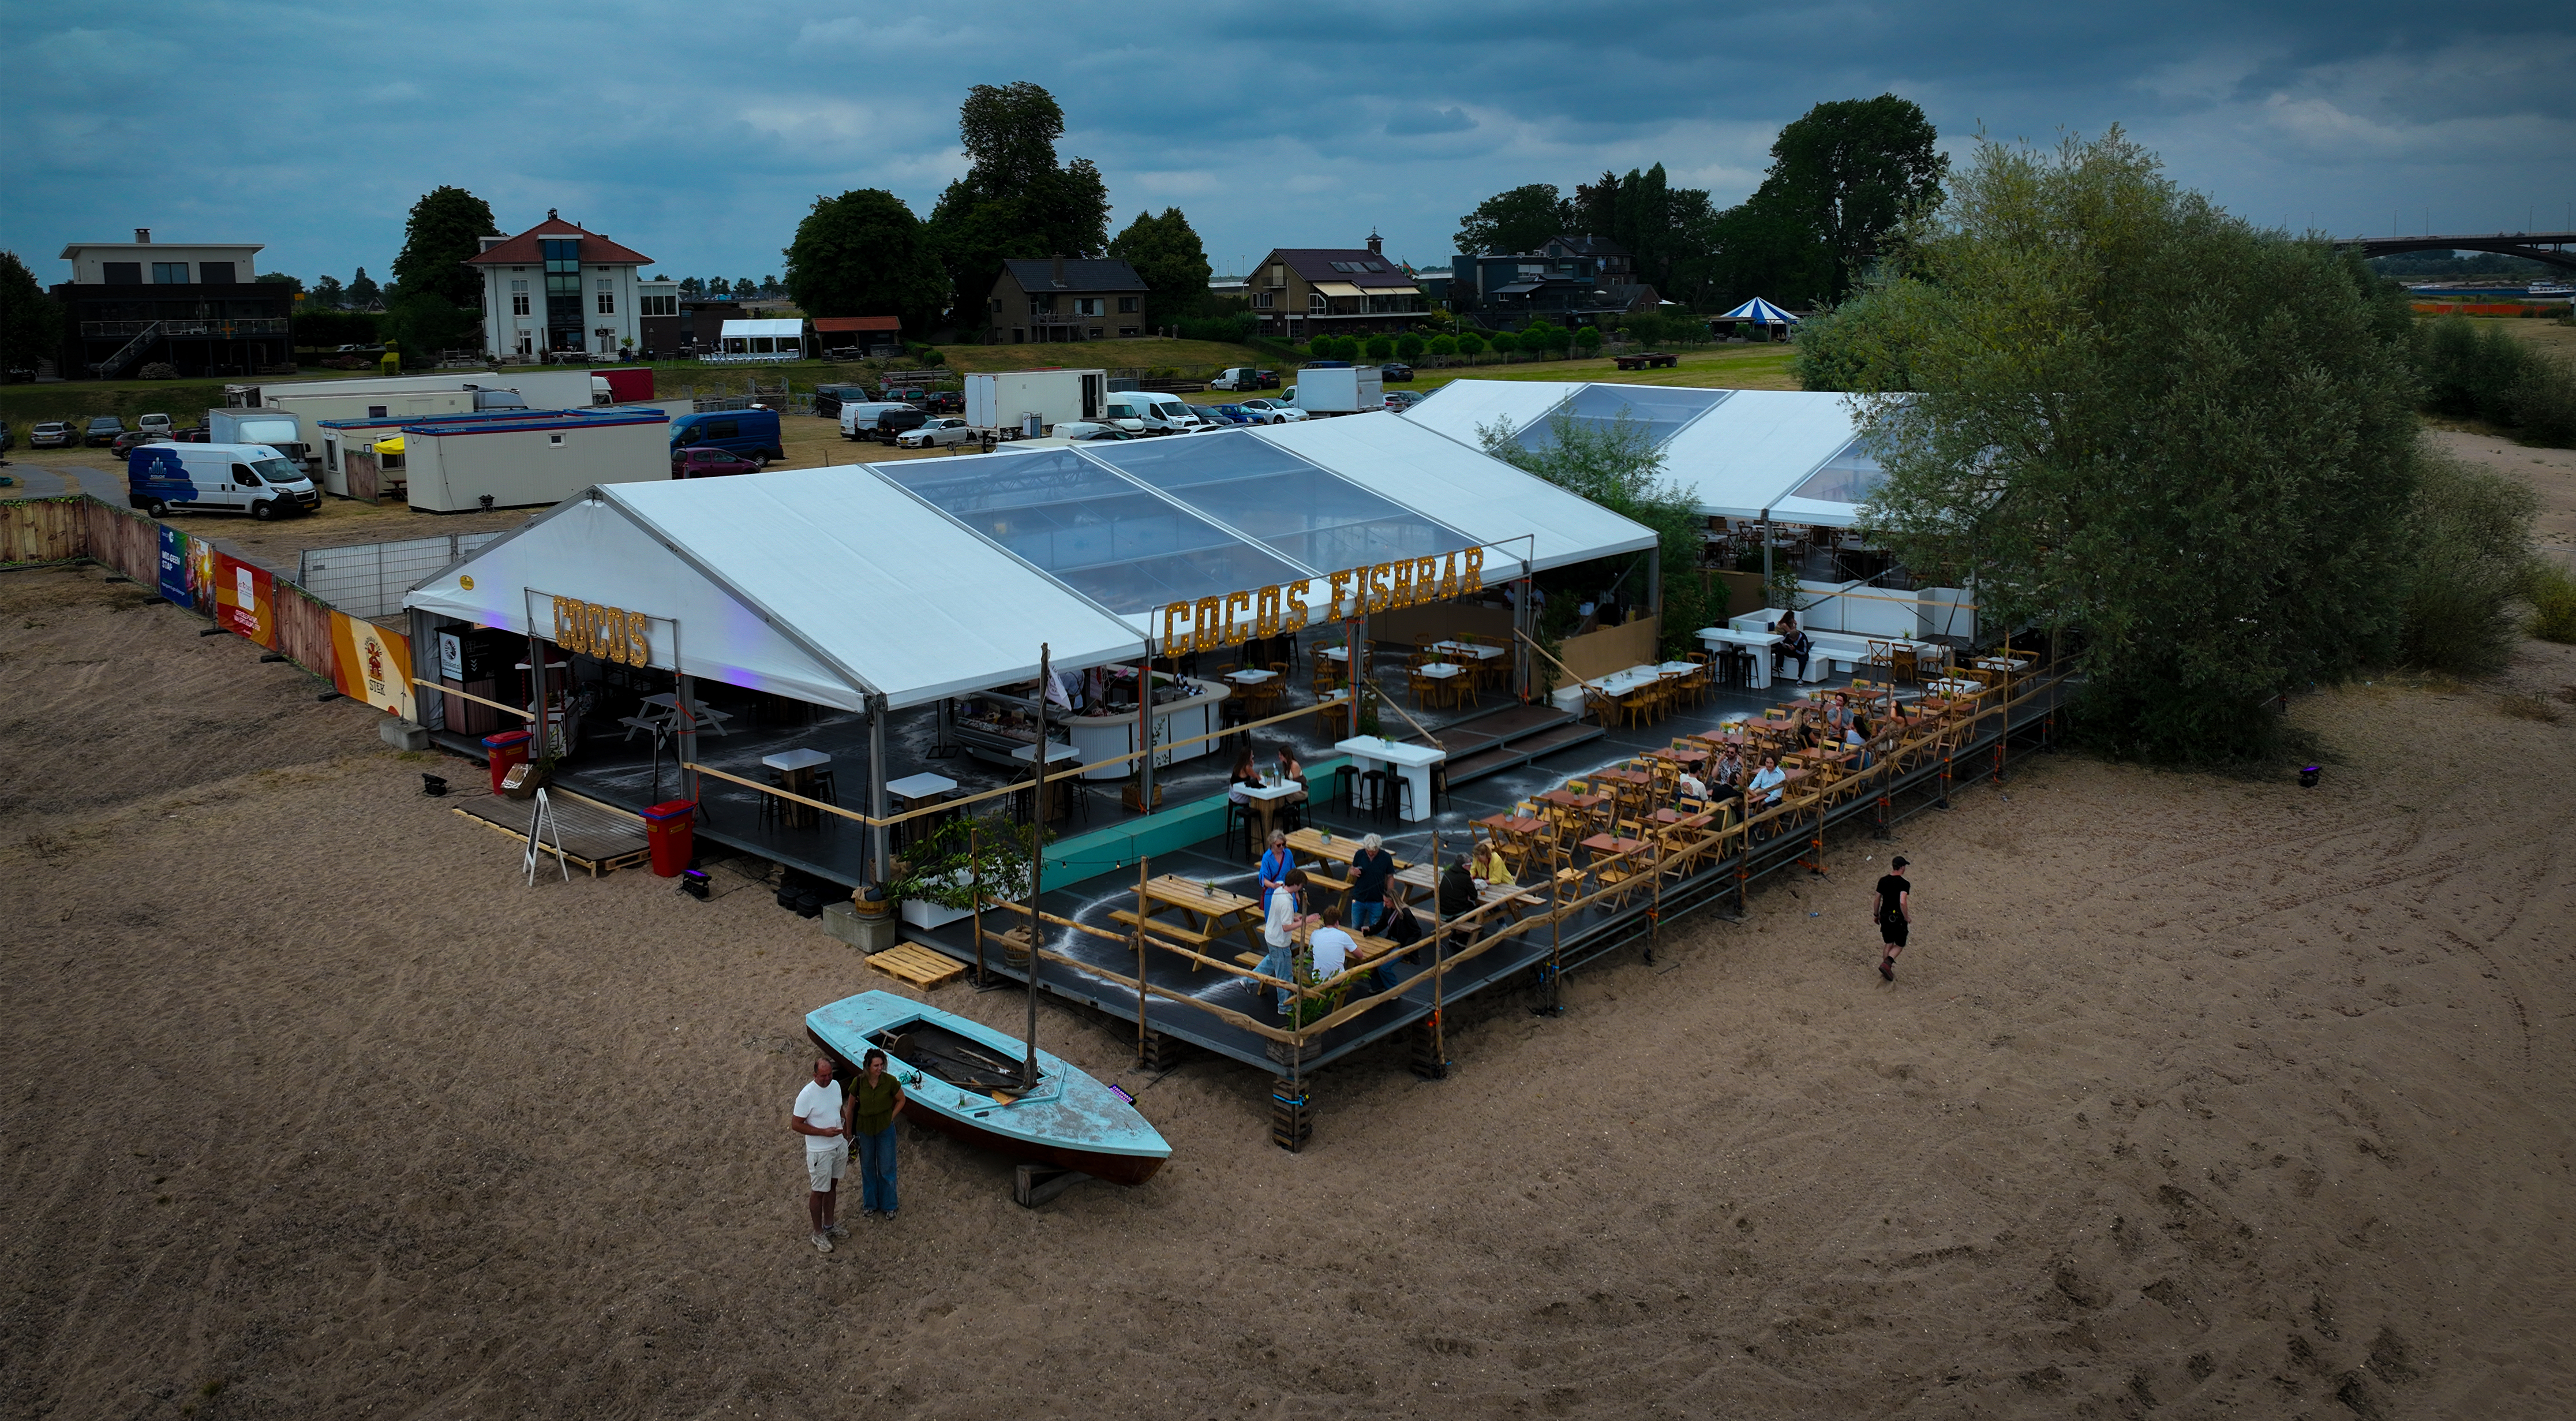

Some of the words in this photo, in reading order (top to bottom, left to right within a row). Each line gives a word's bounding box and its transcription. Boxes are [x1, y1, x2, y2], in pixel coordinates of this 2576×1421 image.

[553, 595, 647, 668] COCOS
[1164, 579, 1310, 659] COCOS
[1328, 546, 1484, 625] FISHBAR
[369, 679, 386, 696] STEK
